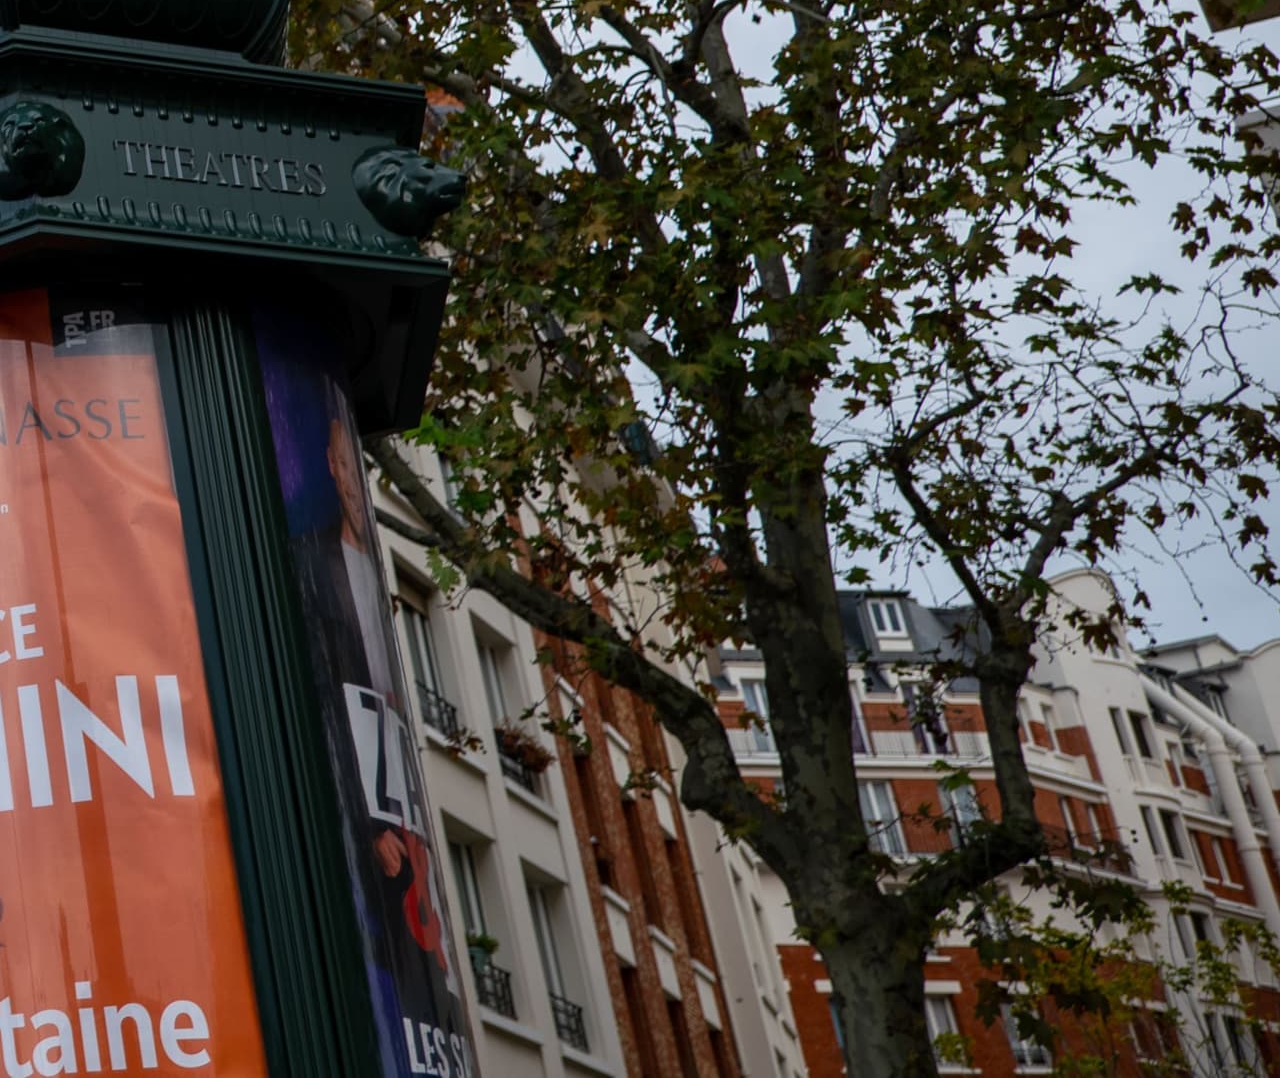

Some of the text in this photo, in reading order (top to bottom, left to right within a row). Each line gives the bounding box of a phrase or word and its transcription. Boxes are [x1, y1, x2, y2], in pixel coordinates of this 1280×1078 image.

[112, 139, 327, 197] THEATRES
[63, 311, 87, 349] TPA
[402, 1017, 450, 1078] LES
